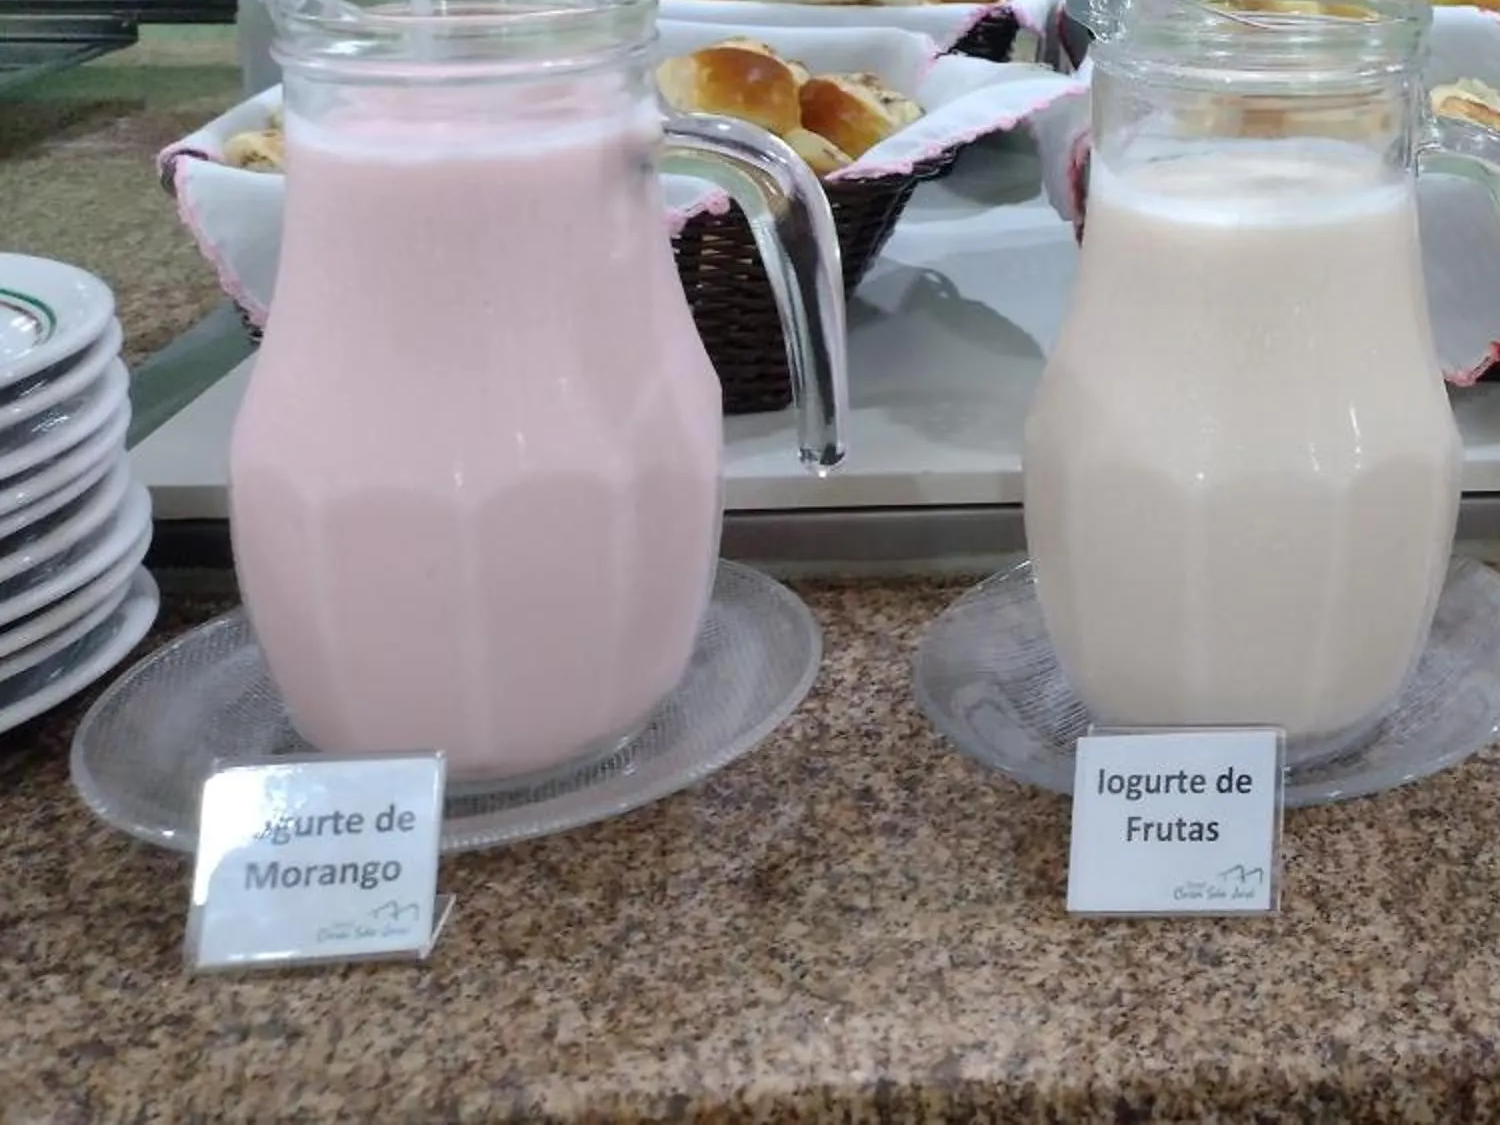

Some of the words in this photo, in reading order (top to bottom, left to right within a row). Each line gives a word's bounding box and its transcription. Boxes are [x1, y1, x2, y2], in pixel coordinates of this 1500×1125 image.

[1098, 768, 1206, 801] Iogurte
[1216, 766, 1253, 794] de
[375, 803, 416, 833] de
[1126, 816, 1220, 842] Frutas
[244, 859, 403, 891] Morango
